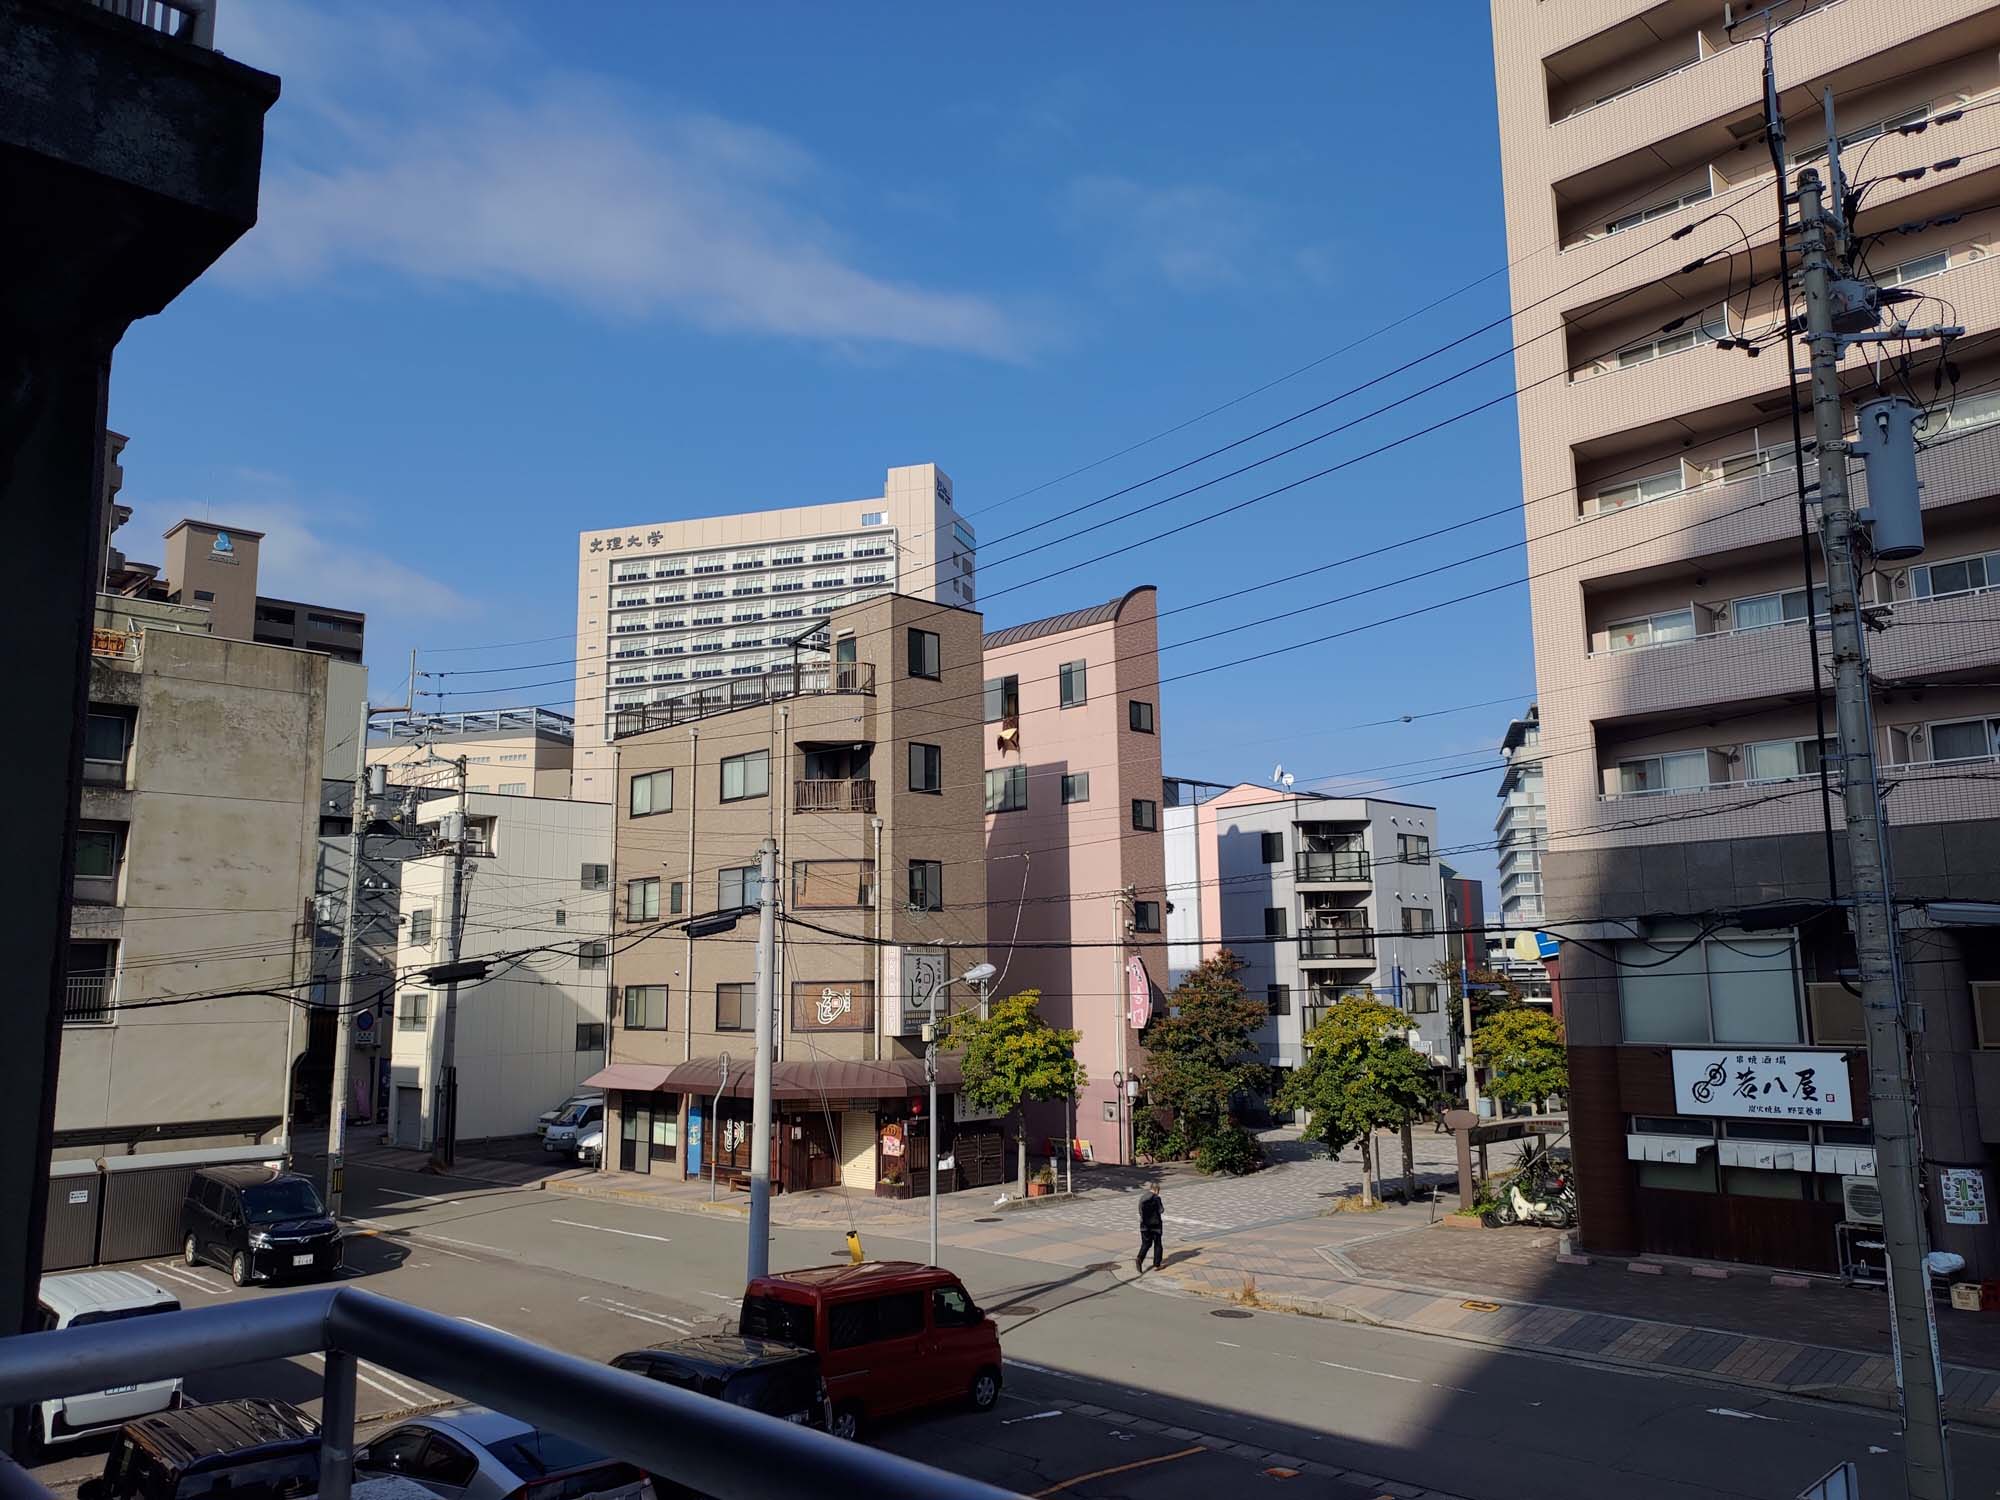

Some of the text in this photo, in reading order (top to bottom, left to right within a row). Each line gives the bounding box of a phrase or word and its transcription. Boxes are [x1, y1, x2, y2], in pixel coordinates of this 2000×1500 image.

[589, 530, 664, 553] 文理大学
[1736, 1055, 1787, 1065] 串焼酒場
[1732, 1067, 1819, 1102] 若八屋
[1748, 1105, 1782, 1114] 炭火焼鳥
